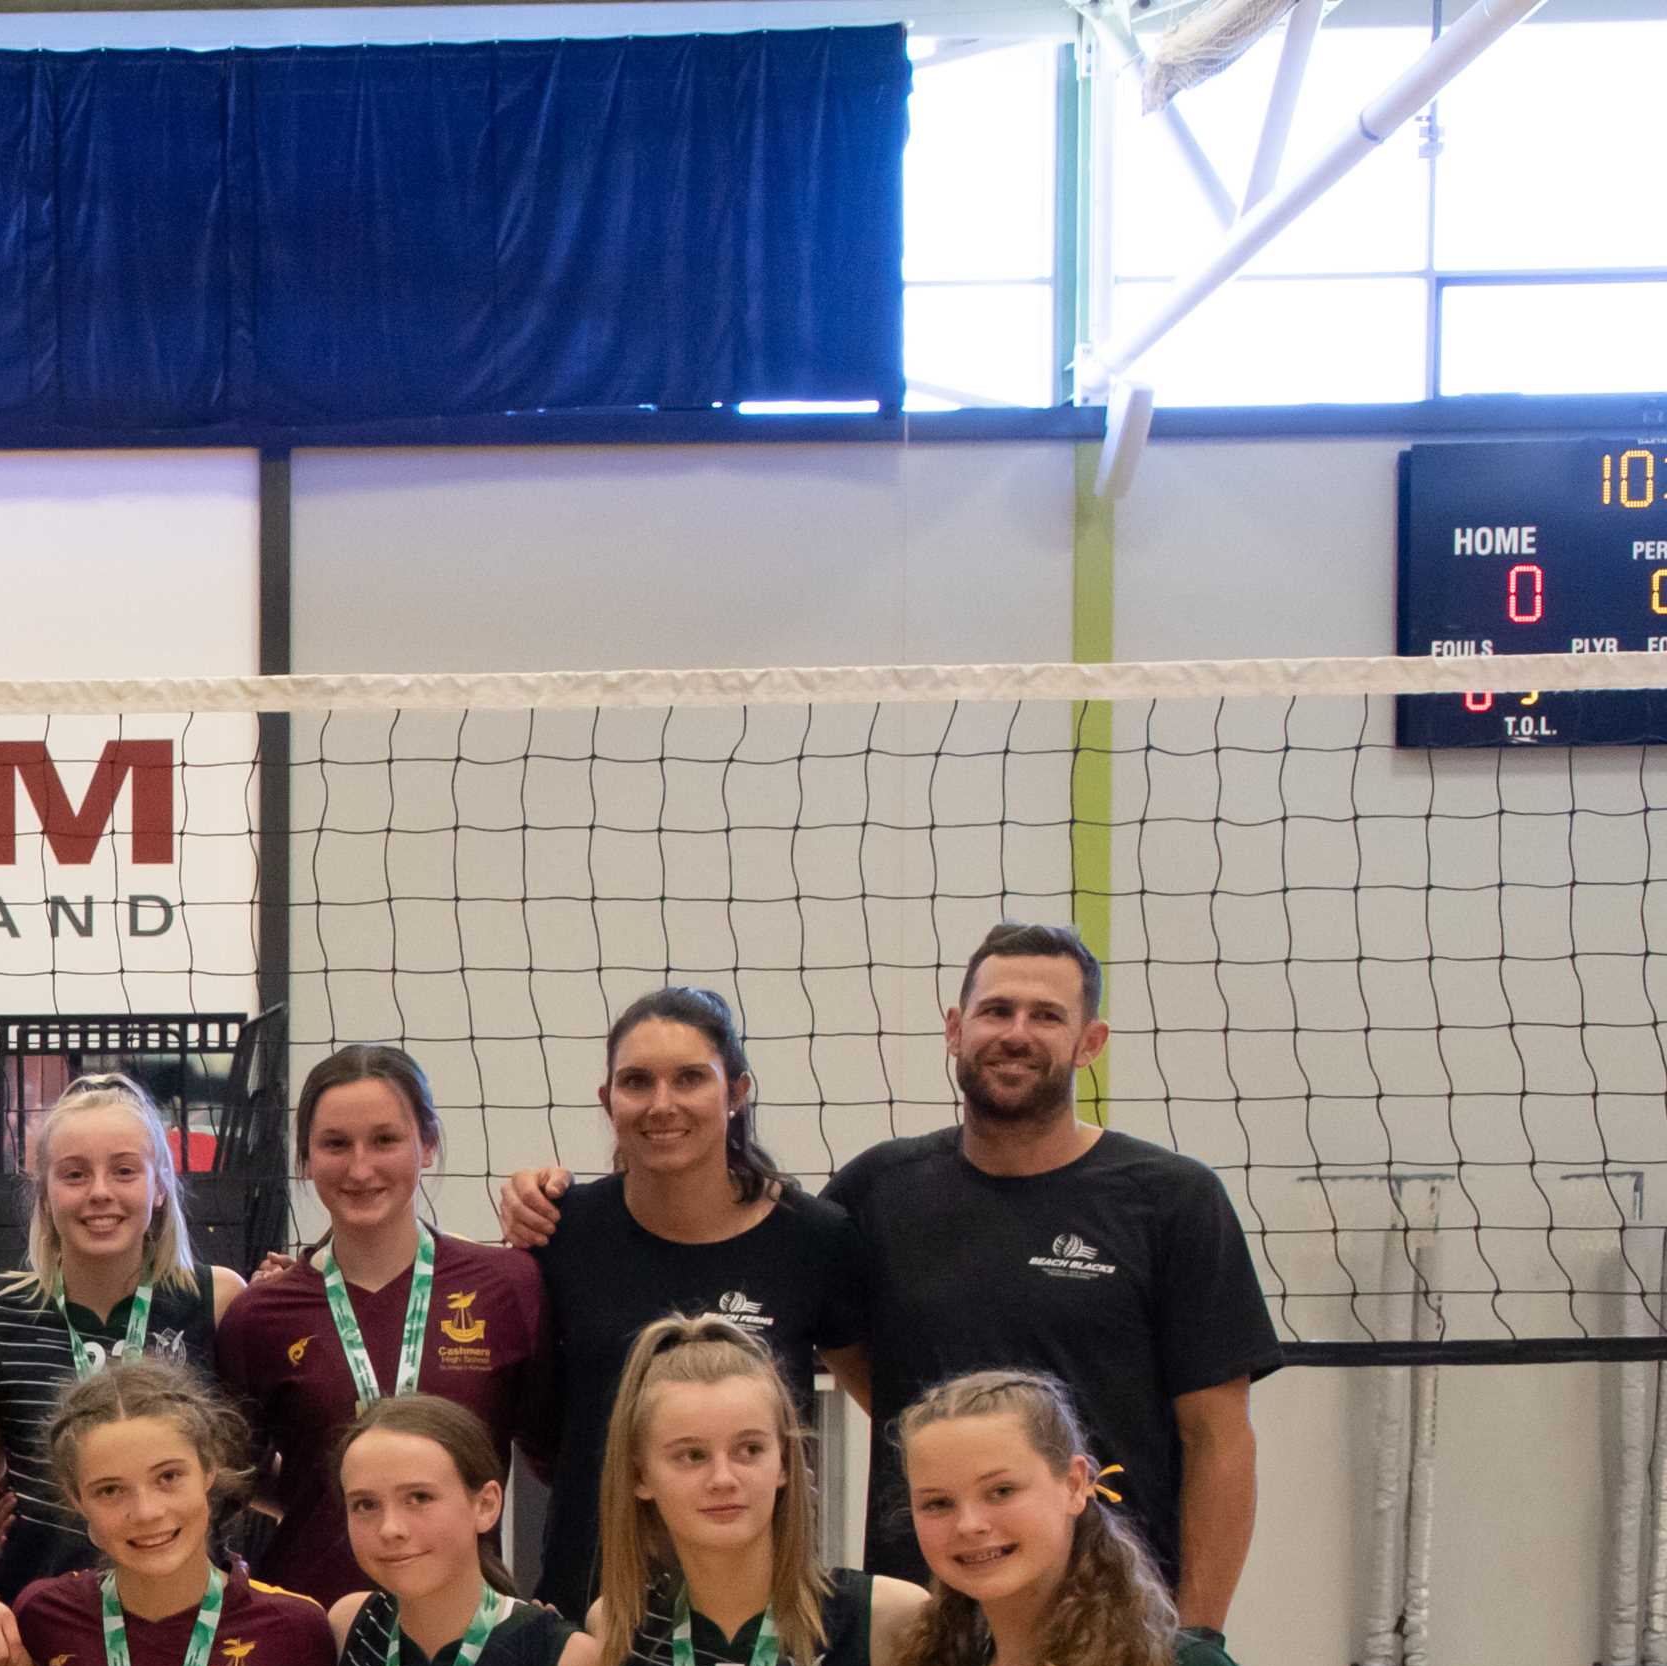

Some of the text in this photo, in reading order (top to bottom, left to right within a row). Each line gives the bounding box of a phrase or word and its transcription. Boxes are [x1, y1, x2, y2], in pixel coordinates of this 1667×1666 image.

[1454, 526, 1537, 556] HOME
[1508, 563, 1543, 623] 0
[1505, 716, 1557, 736] T.O.L.
[1029, 1256, 1070, 1268] BEACH
[1069, 1260, 1116, 1274] BLACKS
